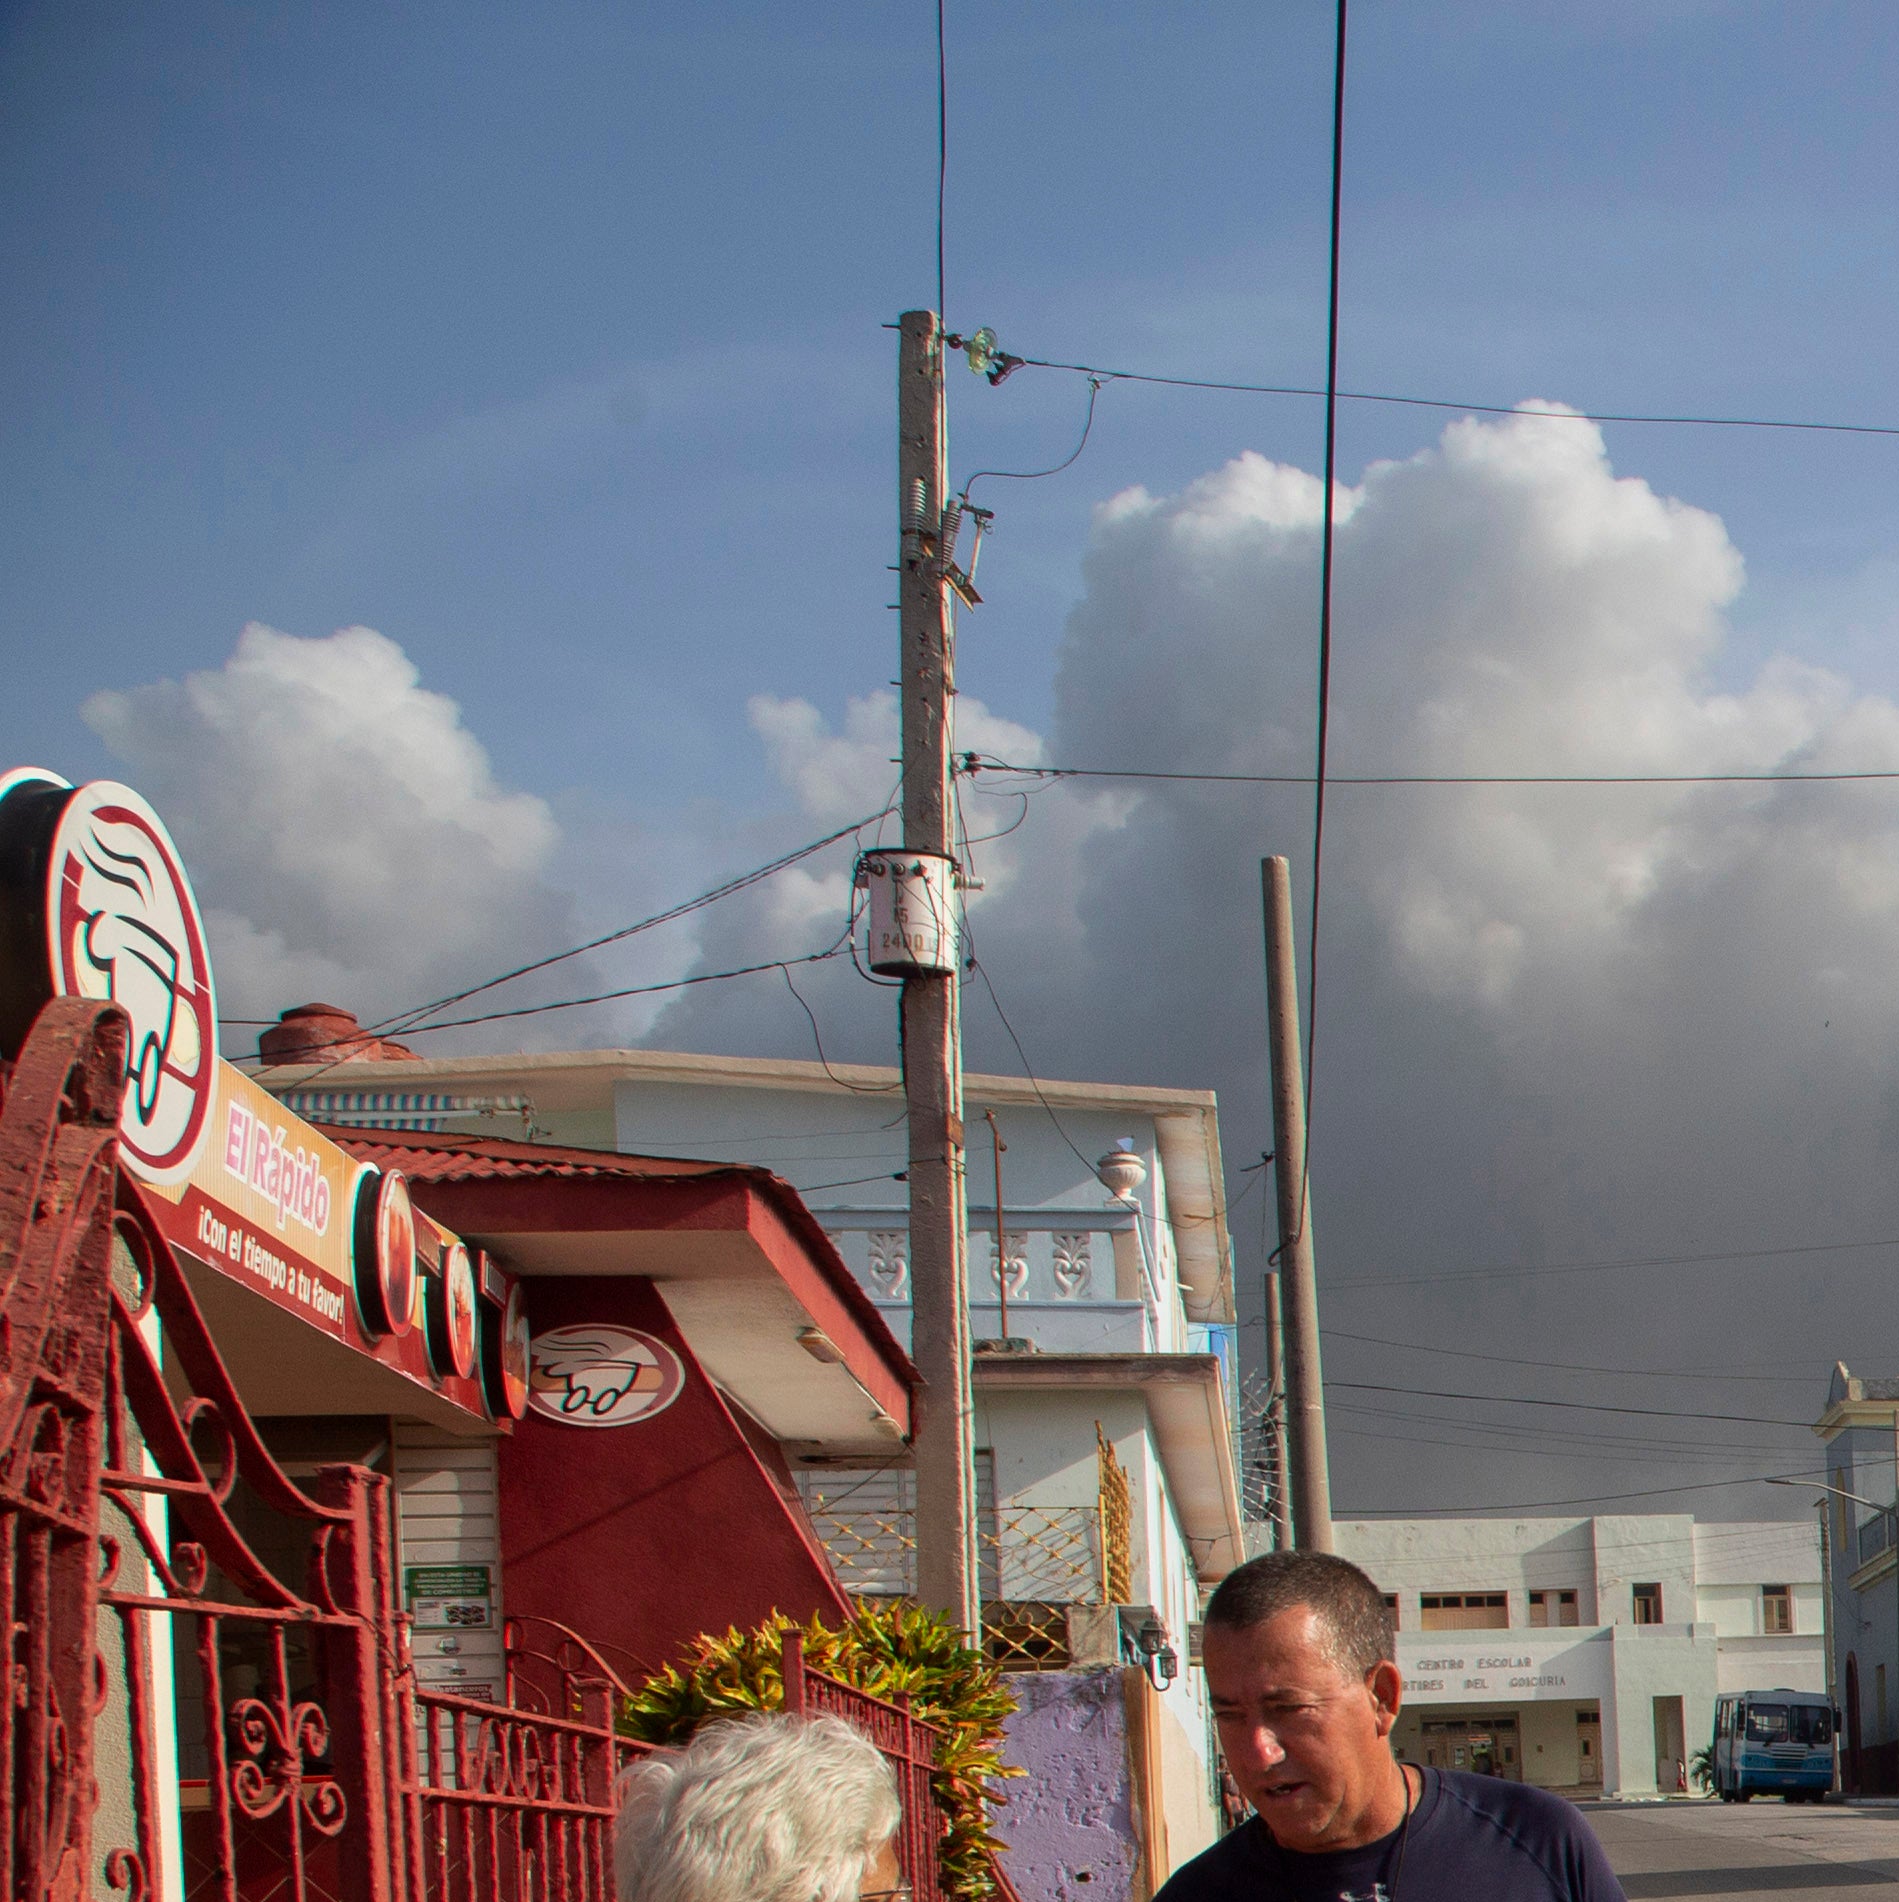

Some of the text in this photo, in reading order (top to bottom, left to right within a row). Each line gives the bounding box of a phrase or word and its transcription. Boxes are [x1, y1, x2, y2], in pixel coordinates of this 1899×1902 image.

[224, 1099, 331, 1238] El Rápido
[198, 1205, 345, 1325] ¡Con el tiempo a tu favor!
[1402, 1676, 1566, 1692] RTIRES DEL GOICURIA
[1416, 1657, 1532, 1671] CENTRO ESCOLAR
